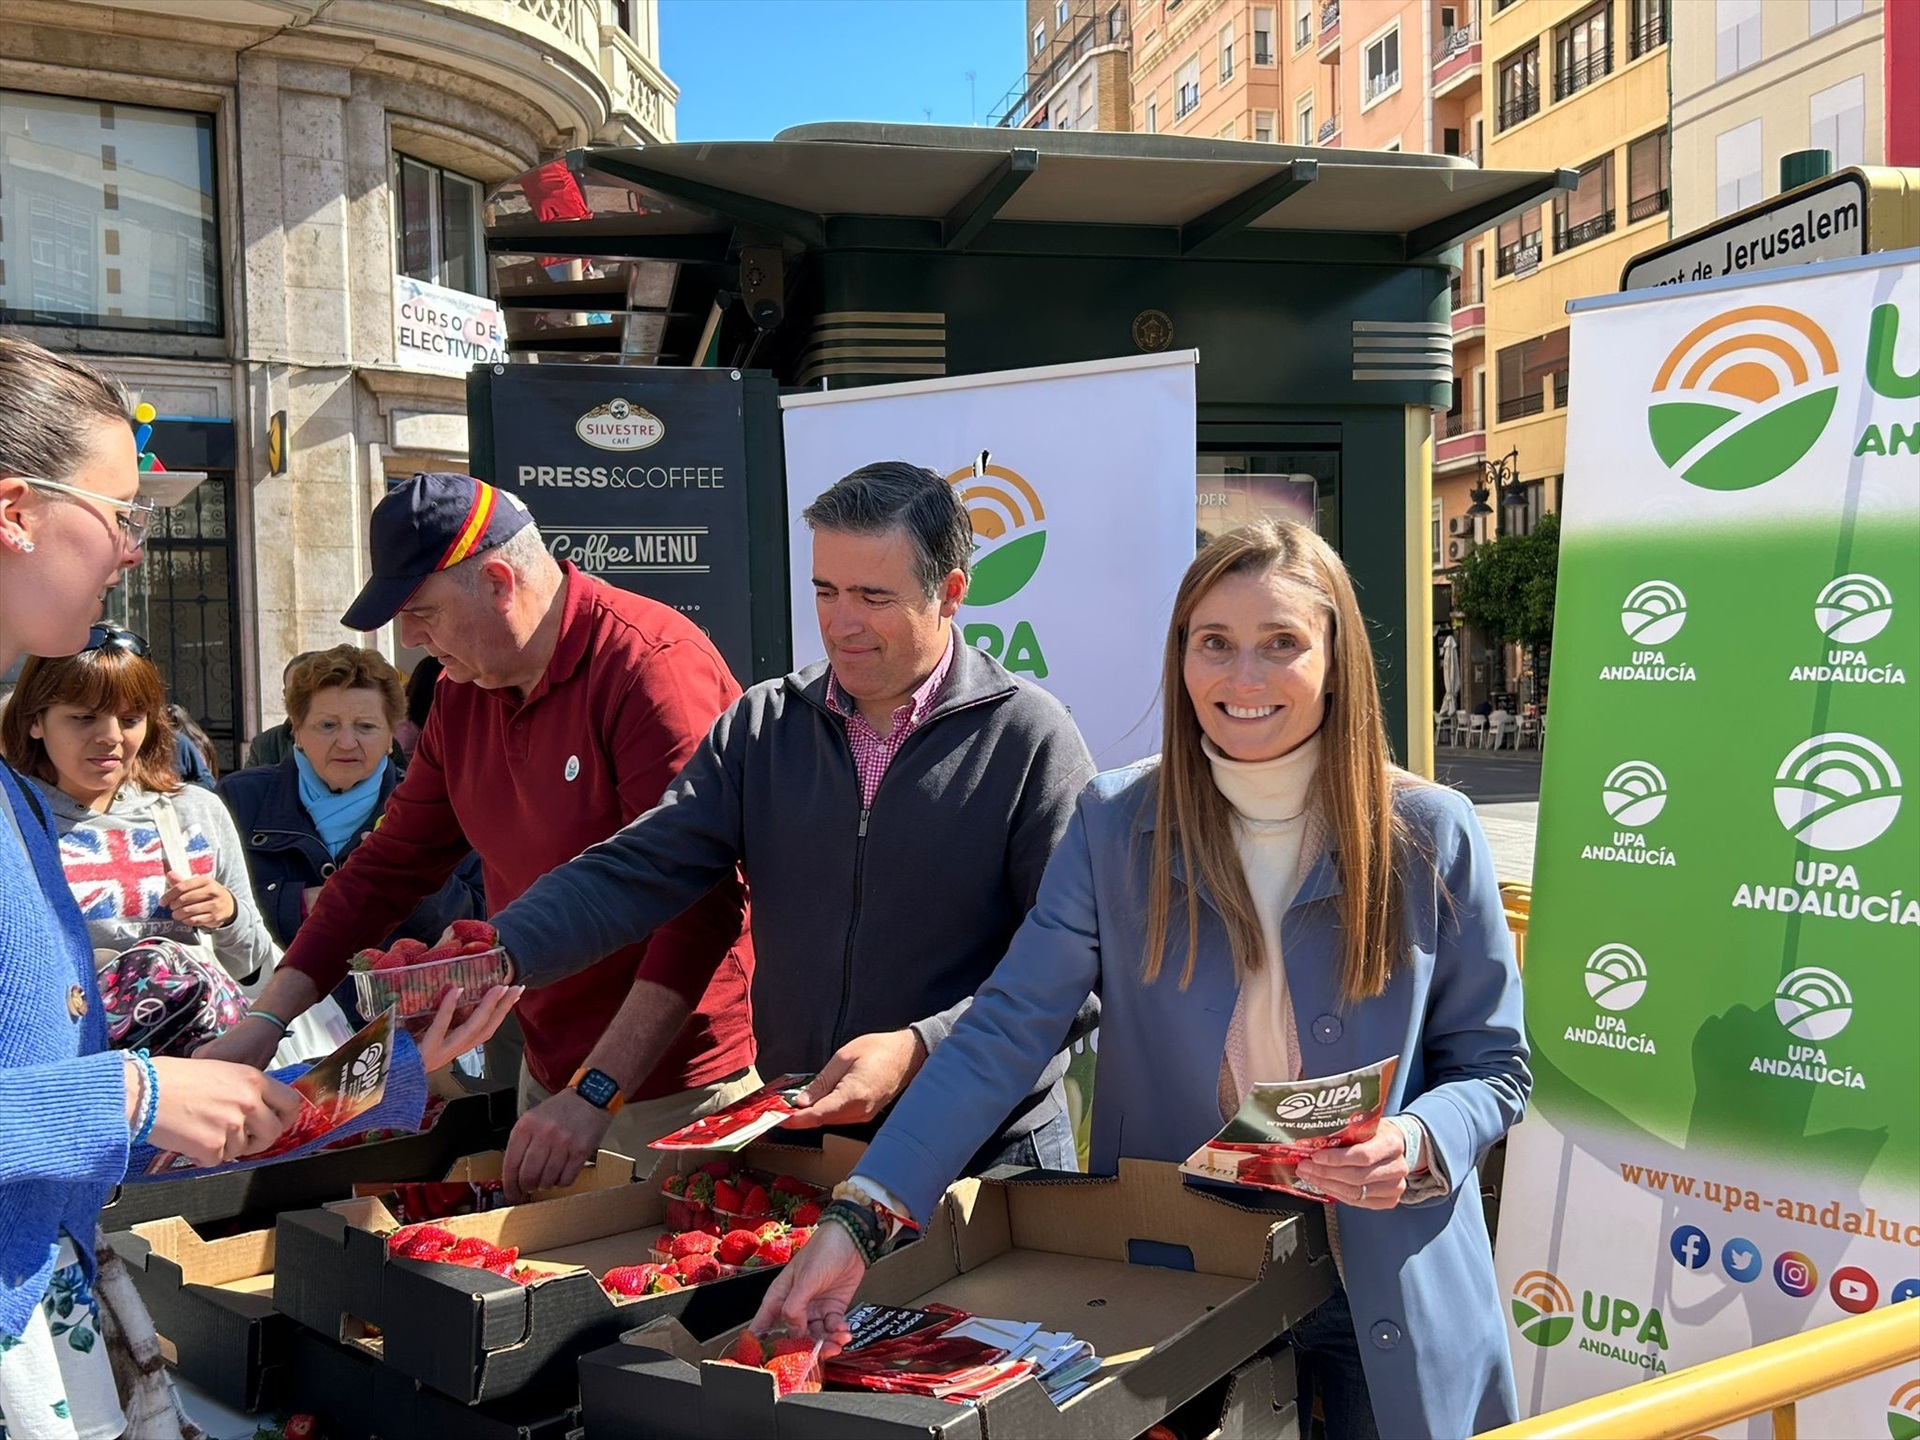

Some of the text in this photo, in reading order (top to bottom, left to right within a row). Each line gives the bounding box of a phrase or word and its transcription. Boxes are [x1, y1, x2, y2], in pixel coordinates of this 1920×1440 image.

[1692, 261, 1713, 281] de
[1722, 202, 1858, 275] Jerusalem
[401, 303, 463, 332] CURSO
[476, 321, 498, 340] DE
[586, 424, 656, 436] SILVESTRE
[612, 437, 630, 445] CAFÉ
[518, 465, 725, 489] PRESS&COFFEE
[1195, 493, 1228, 506] DER
[551, 534, 698, 571] Coffee MENU
[963, 621, 1049, 679] PA
[1632, 651, 1665, 666] UPA
[1828, 650, 1867, 666] UPA
[1599, 663, 1696, 682] ANDALUCÍA
[1789, 664, 1906, 684] ANDALUCÍA
[1613, 832, 1646, 848] UPA
[1581, 847, 1676, 866] ANDALUCÍA
[1795, 861, 1859, 891] UPA
[1732, 884, 1920, 927] ANDALUCÍA
[1595, 1015, 1627, 1033] UPA
[1564, 1026, 1656, 1055] ANDALUCÍA
[1788, 1045, 1827, 1065] UPA
[1750, 1057, 1866, 1089] ANDALUCÍA
[1316, 1082, 1361, 1108] UPA
[849, 1306, 877, 1324] UPA
[1582, 1290, 1668, 1350] UPA
[1579, 1337, 1667, 1374] ANDALUCÍA
